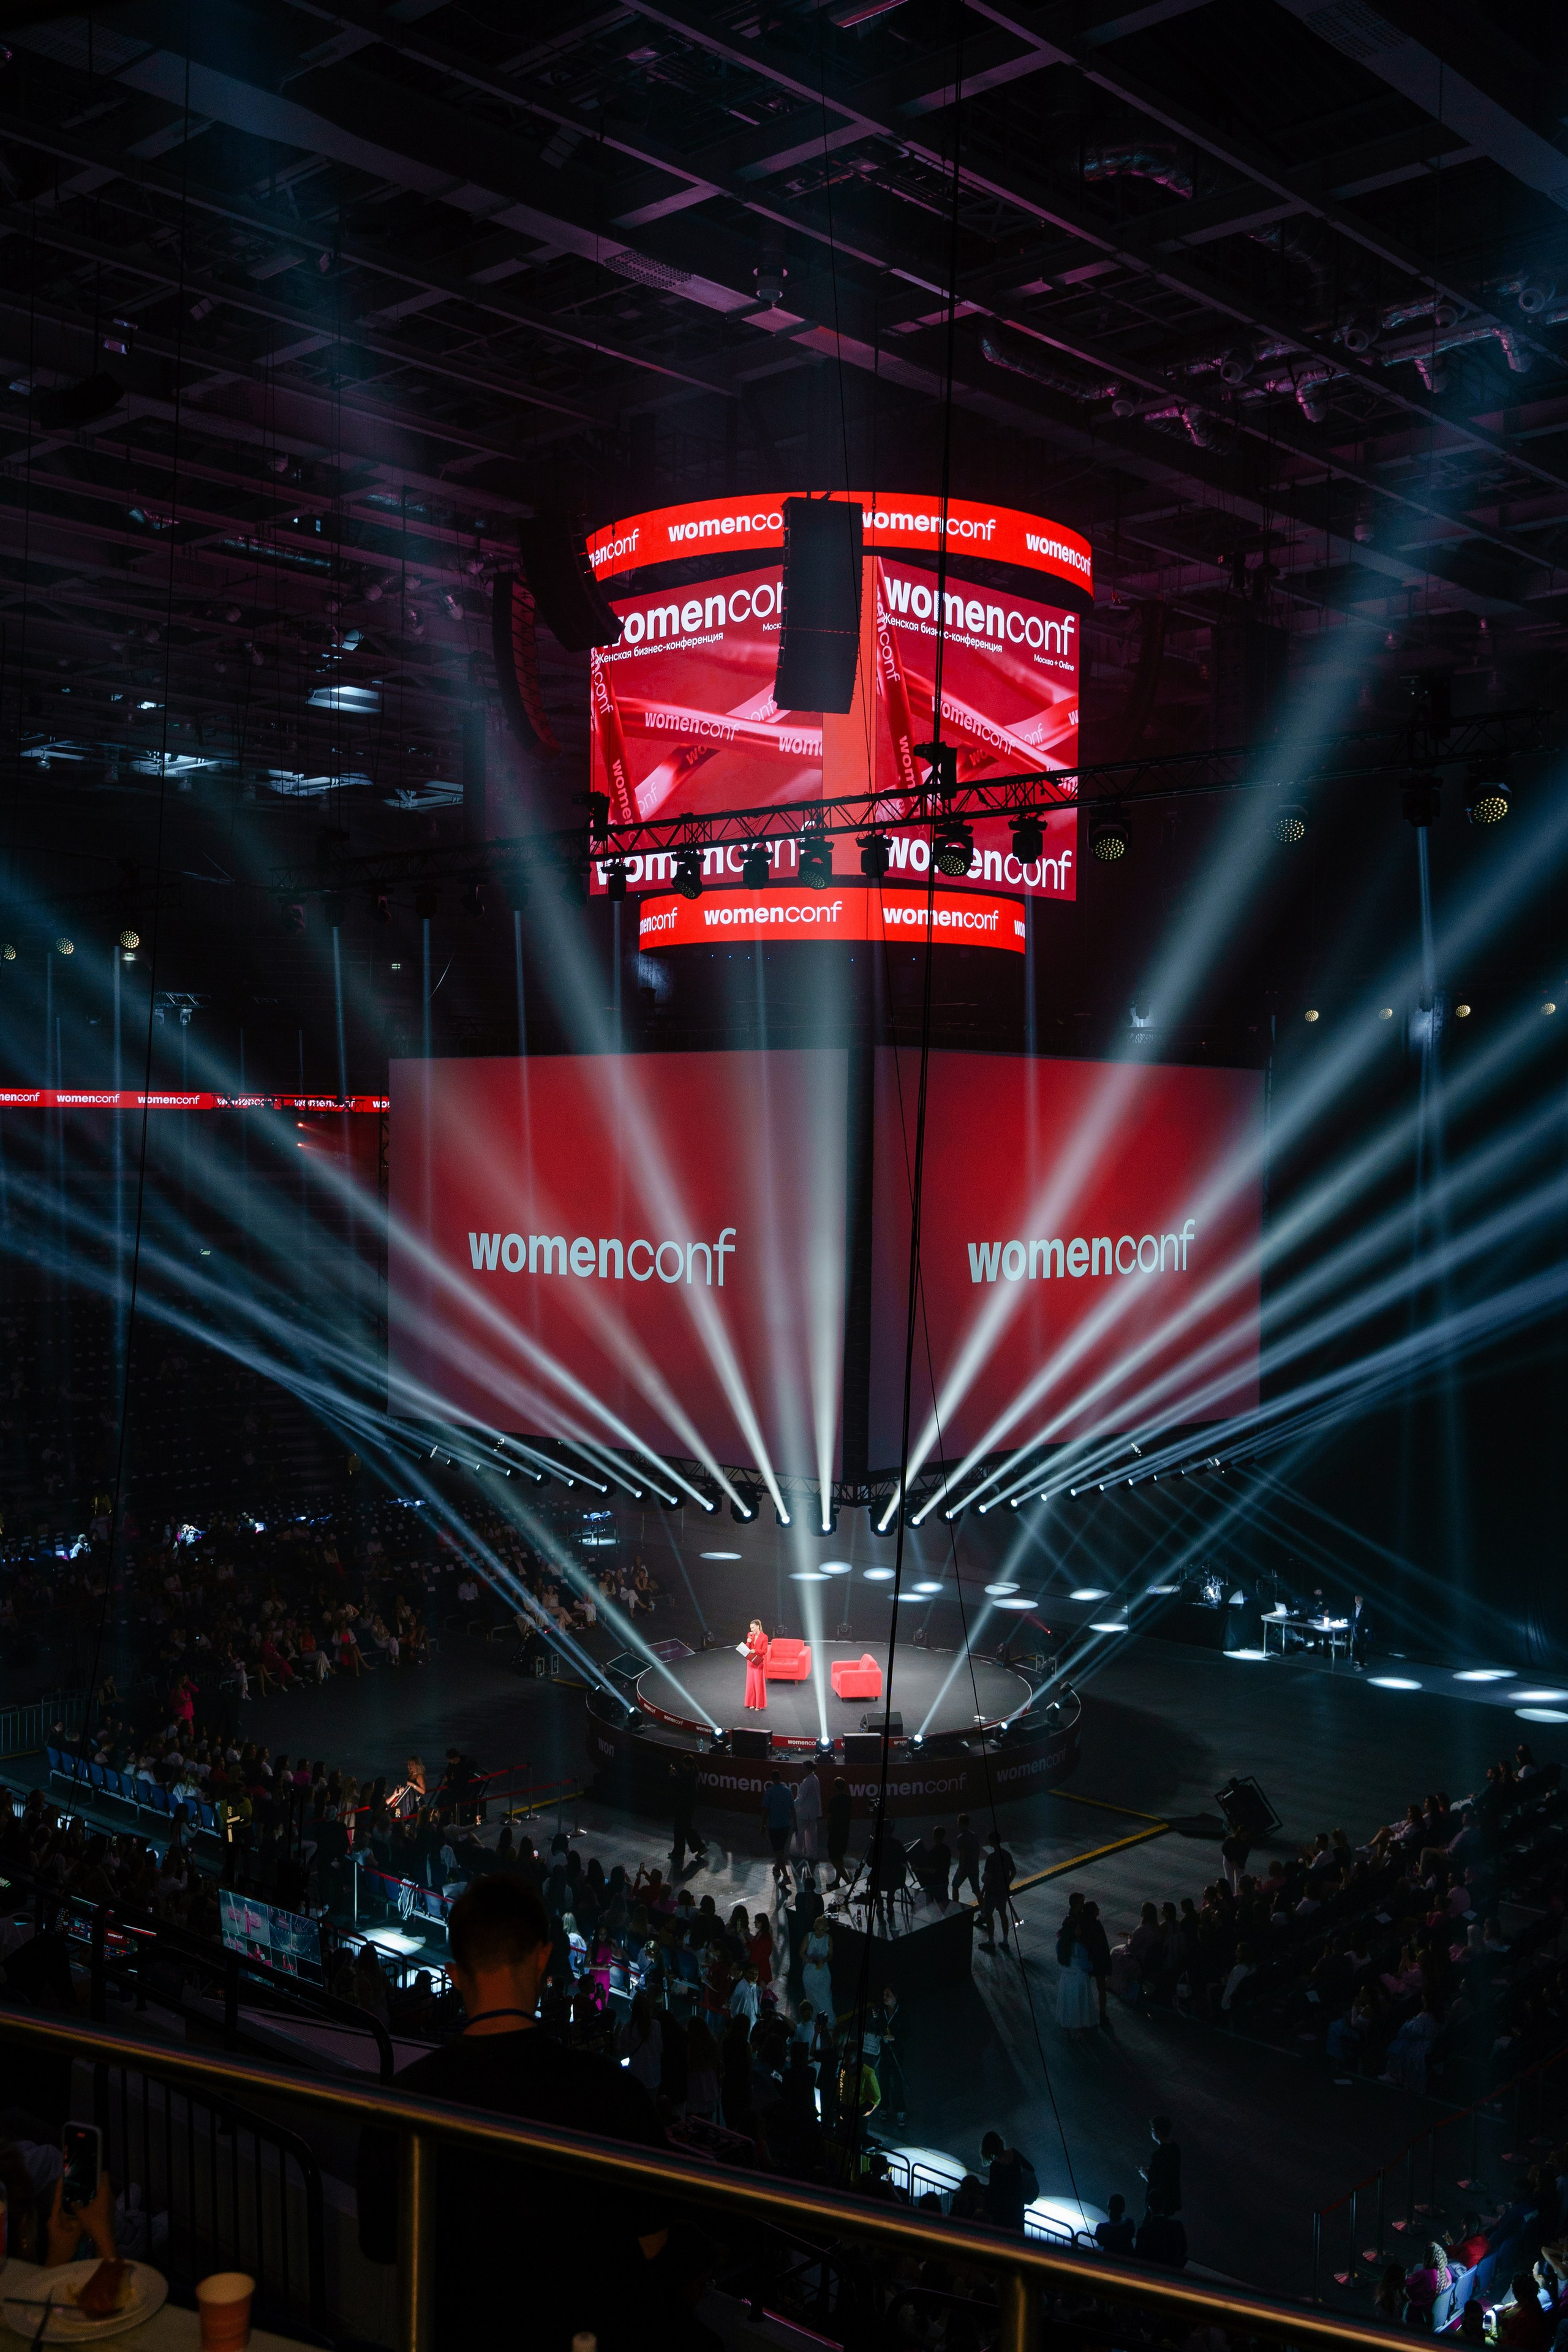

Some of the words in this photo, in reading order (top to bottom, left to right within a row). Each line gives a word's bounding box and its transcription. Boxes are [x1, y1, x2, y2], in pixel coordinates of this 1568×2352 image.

[1025, 533, 1091, 577] womenconf
[602, 581, 783, 648] omenco
[763, 622, 782, 632] Моск
[882, 612, 919, 631] Женская
[921, 622, 1003, 653] бизнс-конференция
[884, 576, 1075, 656] womenconf
[595, 650, 632, 665] Женская
[633, 631, 724, 657] бизнес-конференция
[1034, 654, 1054, 666] Москва
[1058, 661, 1074, 671] Online
[645, 712, 740, 741] womenconf
[595, 820, 815, 886] omncnf
[883, 835, 1072, 891] woenconf
[704, 900, 843, 925] womenconf
[883, 907, 999, 931] womenconf
[56, 1093, 120, 1103] womenconf
[138, 1095, 200, 1105] womenconf
[469, 1227, 736, 1286] womenconf
[967, 1219, 1196, 1283] womenconf
[997, 1745, 1067, 1783] womenconf
[848, 1772, 967, 1797] womenconf
